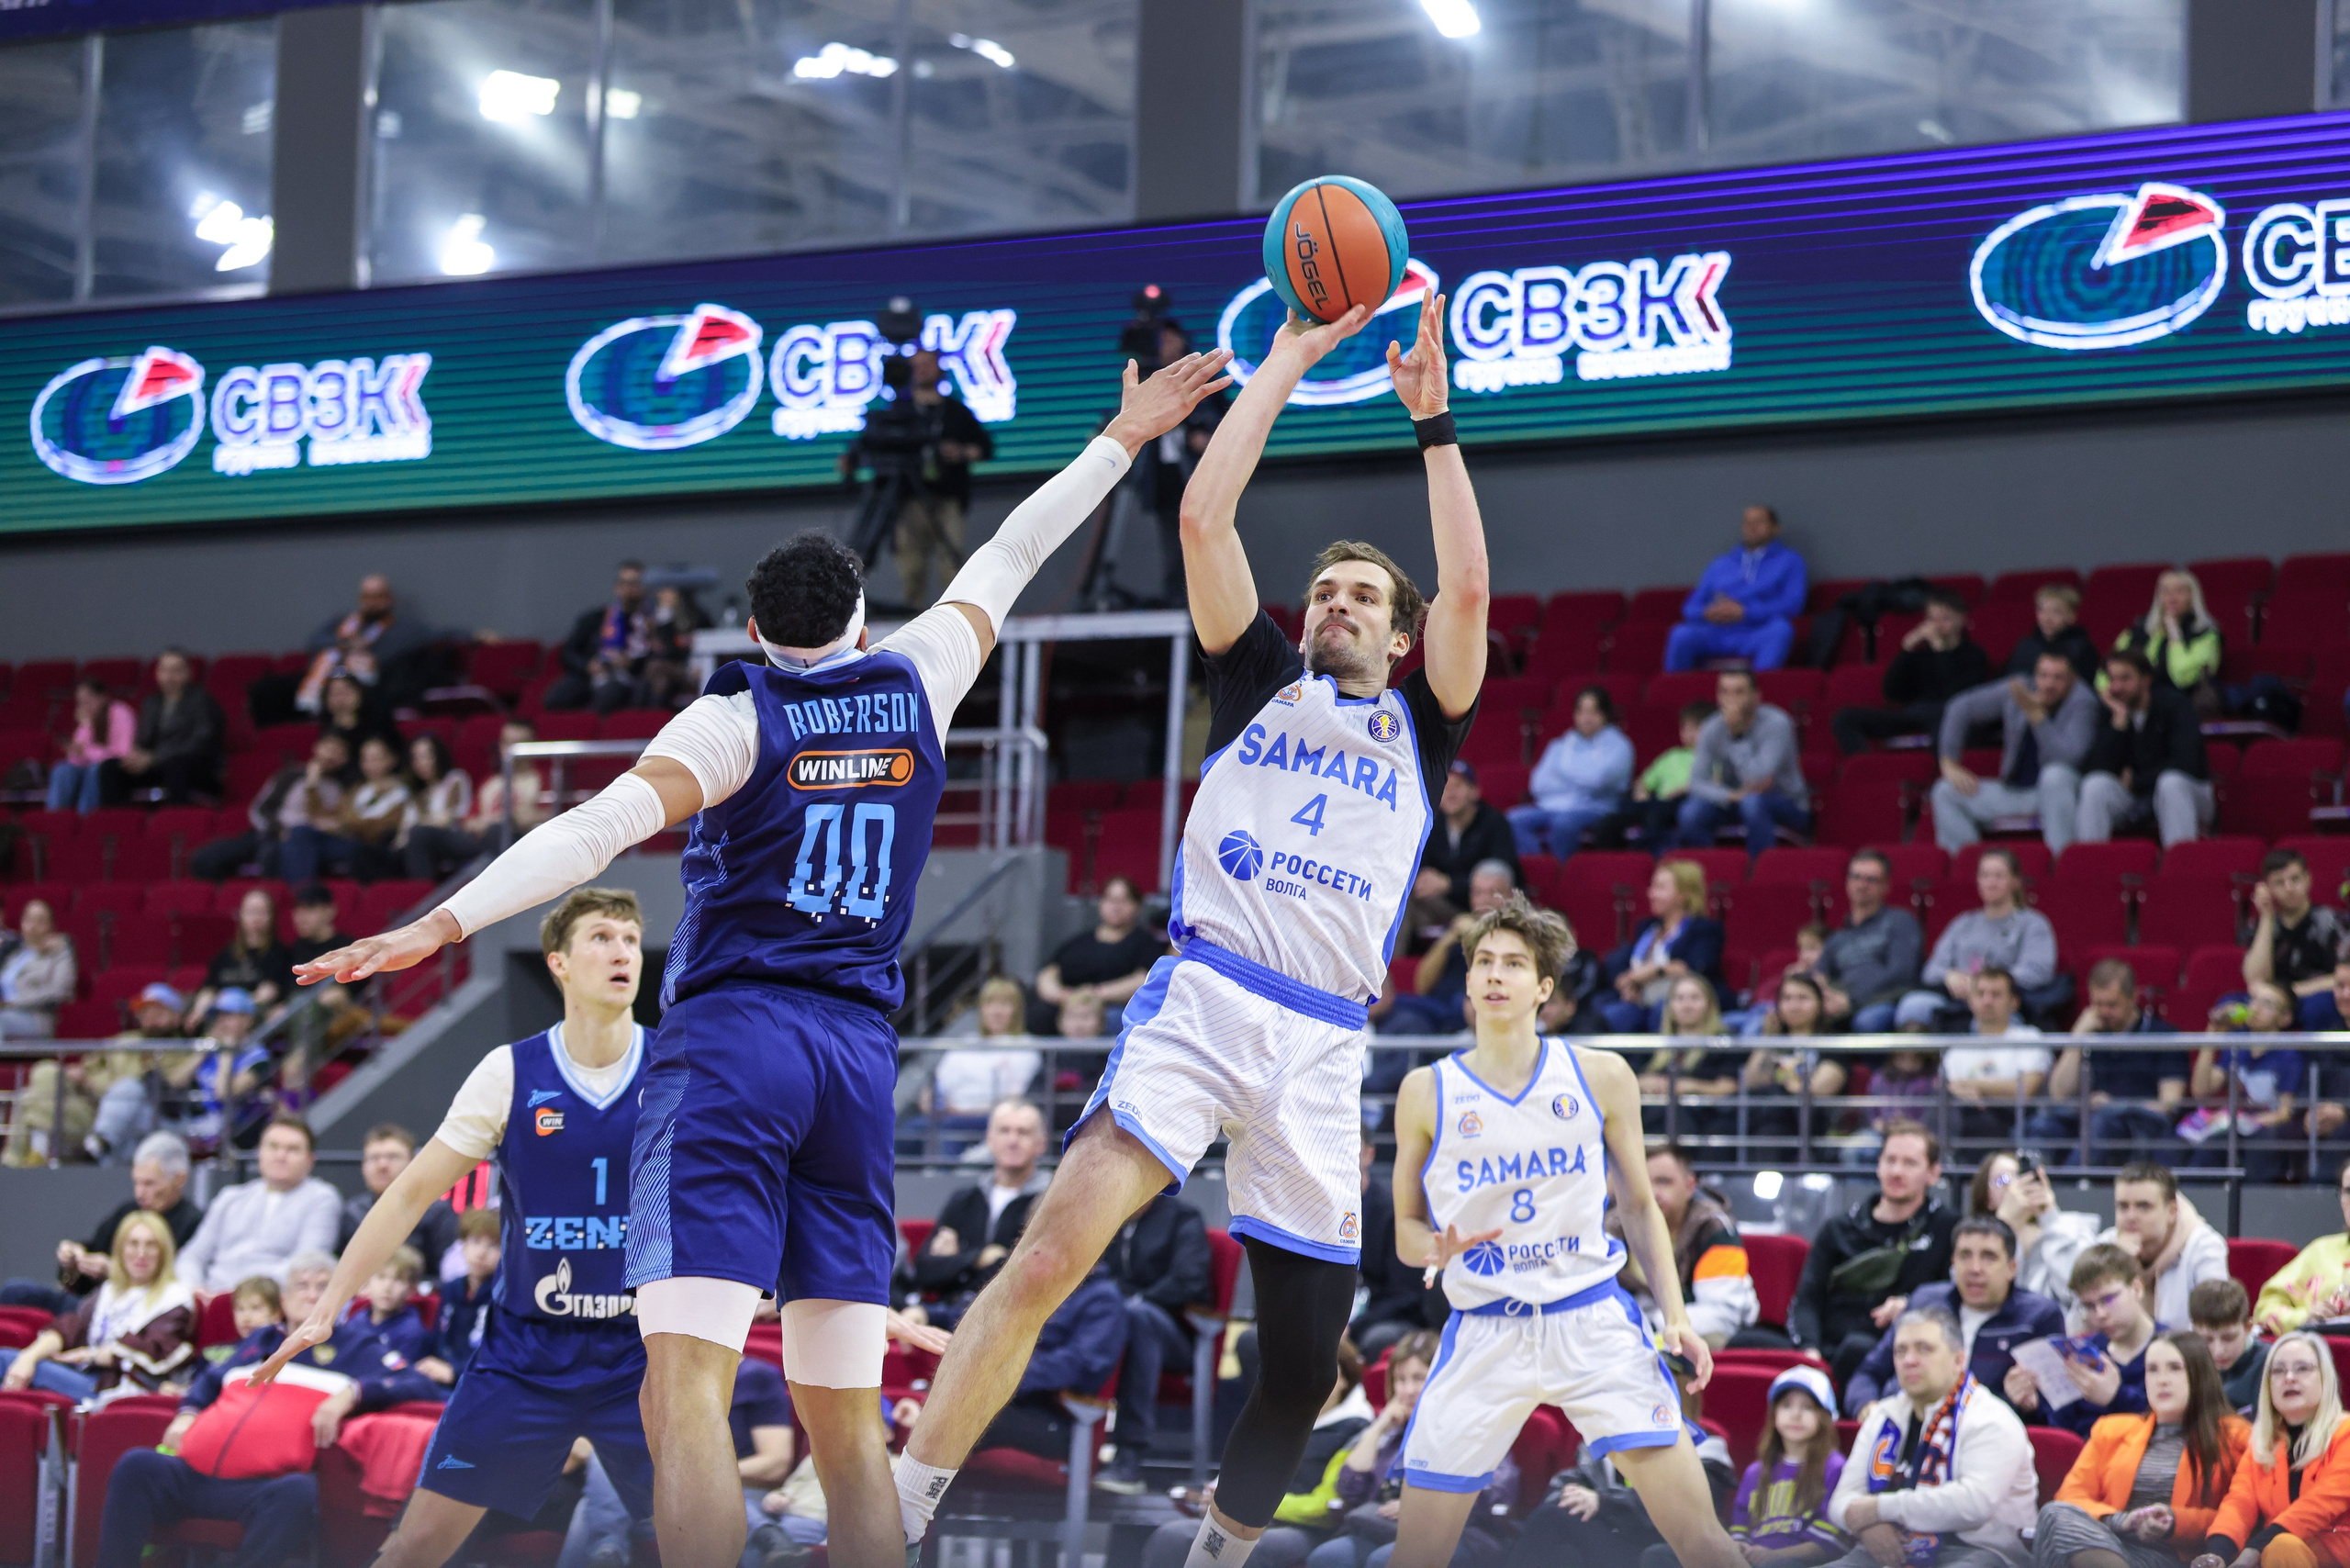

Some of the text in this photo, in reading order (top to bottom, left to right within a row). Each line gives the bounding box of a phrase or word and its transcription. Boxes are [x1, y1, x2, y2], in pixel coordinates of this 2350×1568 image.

[1294, 222, 1329, 310] JÖGEL
[769, 309, 1016, 411] СВК
[783, 692, 918, 741] ROBERSON
[799, 757, 892, 781] WINLINE
[1238, 722, 1398, 812] SAMARA
[1291, 793, 1327, 836] 4
[786, 802, 895, 921] 00
[1270, 851, 1372, 902] РОССЕТИ
[1266, 878, 1306, 900] ВОЛГА
[590, 1158, 607, 1205] 1
[1458, 1144, 1586, 1193] SAMARA
[1510, 1188, 1536, 1224] 8
[1509, 1237, 1580, 1261] РОССТИ
[1513, 1259, 1550, 1274] ВОЛГА
